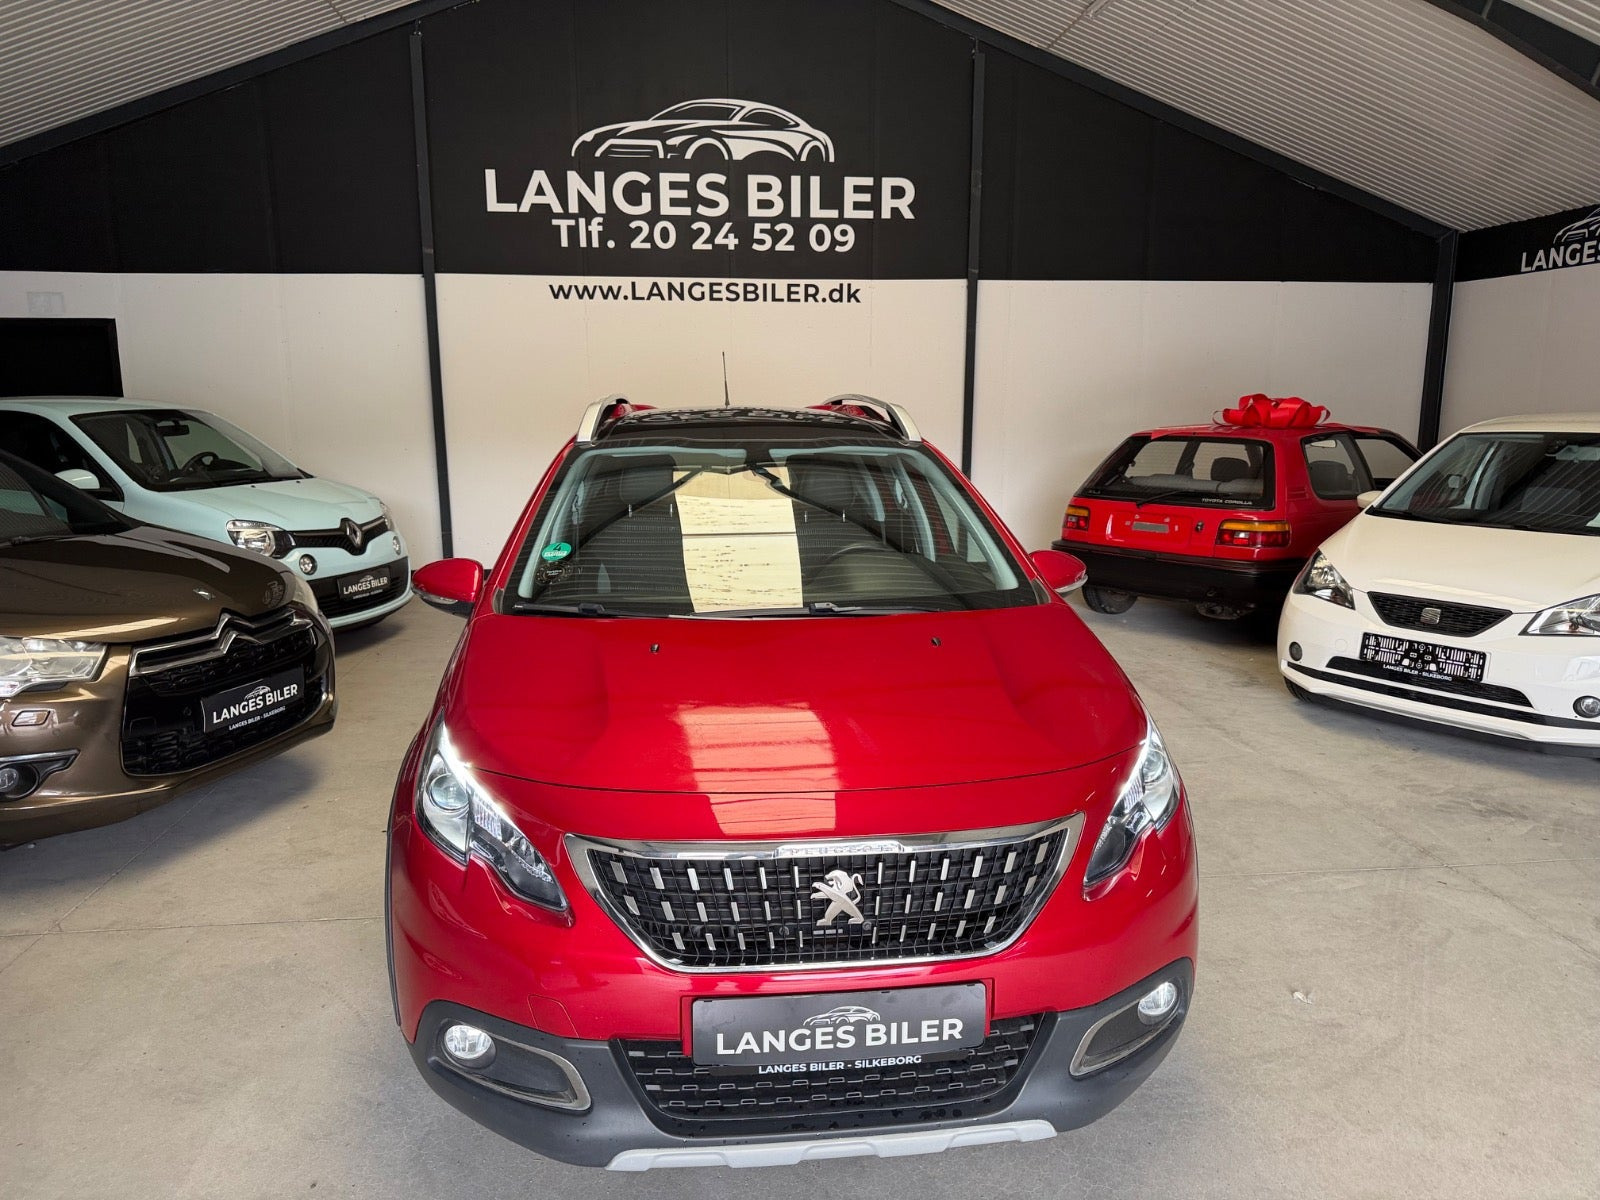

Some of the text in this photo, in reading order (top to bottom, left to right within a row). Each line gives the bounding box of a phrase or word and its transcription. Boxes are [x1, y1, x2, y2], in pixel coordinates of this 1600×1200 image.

[484, 168, 917, 220] LANGES BILER
[551, 216, 856, 253] Tlf. 20 24 52 09
[1520, 240, 1600, 273] LANGE
[548, 280, 862, 304] www.LANGESBILER.dk
[343, 581, 371, 595] LANGES
[371, 577, 388, 588] BILER
[1382, 664, 1403, 673] LANGES
[212, 683, 298, 724] LANGES BILER
[228, 719, 248, 731] LANGES
[716, 1018, 964, 1055] LANGES BILER
[758, 1063, 807, 1075] LANGES
[809, 1061, 845, 1072] BILER
[854, 1055, 923, 1070] SILKEBORG
